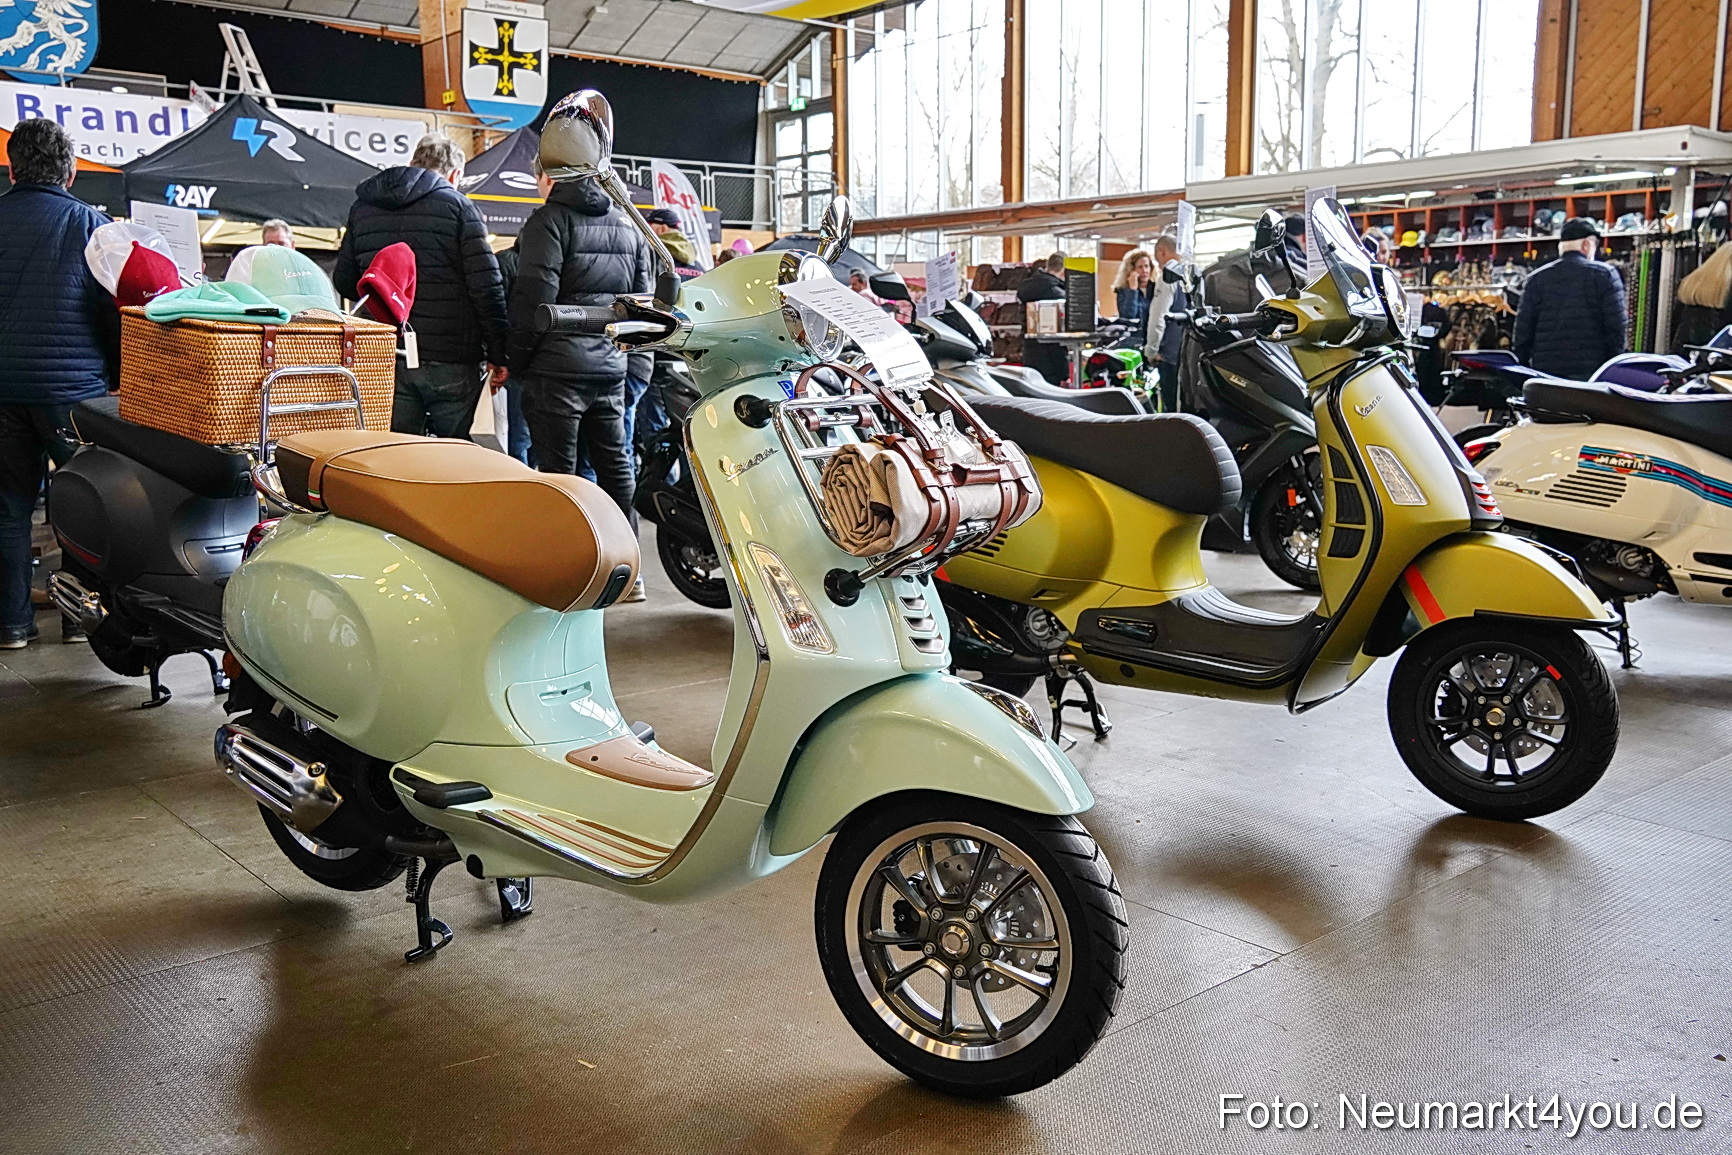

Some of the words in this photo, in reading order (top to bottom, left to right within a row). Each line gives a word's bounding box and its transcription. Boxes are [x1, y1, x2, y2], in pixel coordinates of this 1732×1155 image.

[72, 139, 124, 158] ach
[165, 184, 217, 208] RAY
[718, 447, 780, 483] Vespa
[1599, 455, 1651, 472] MARTINI
